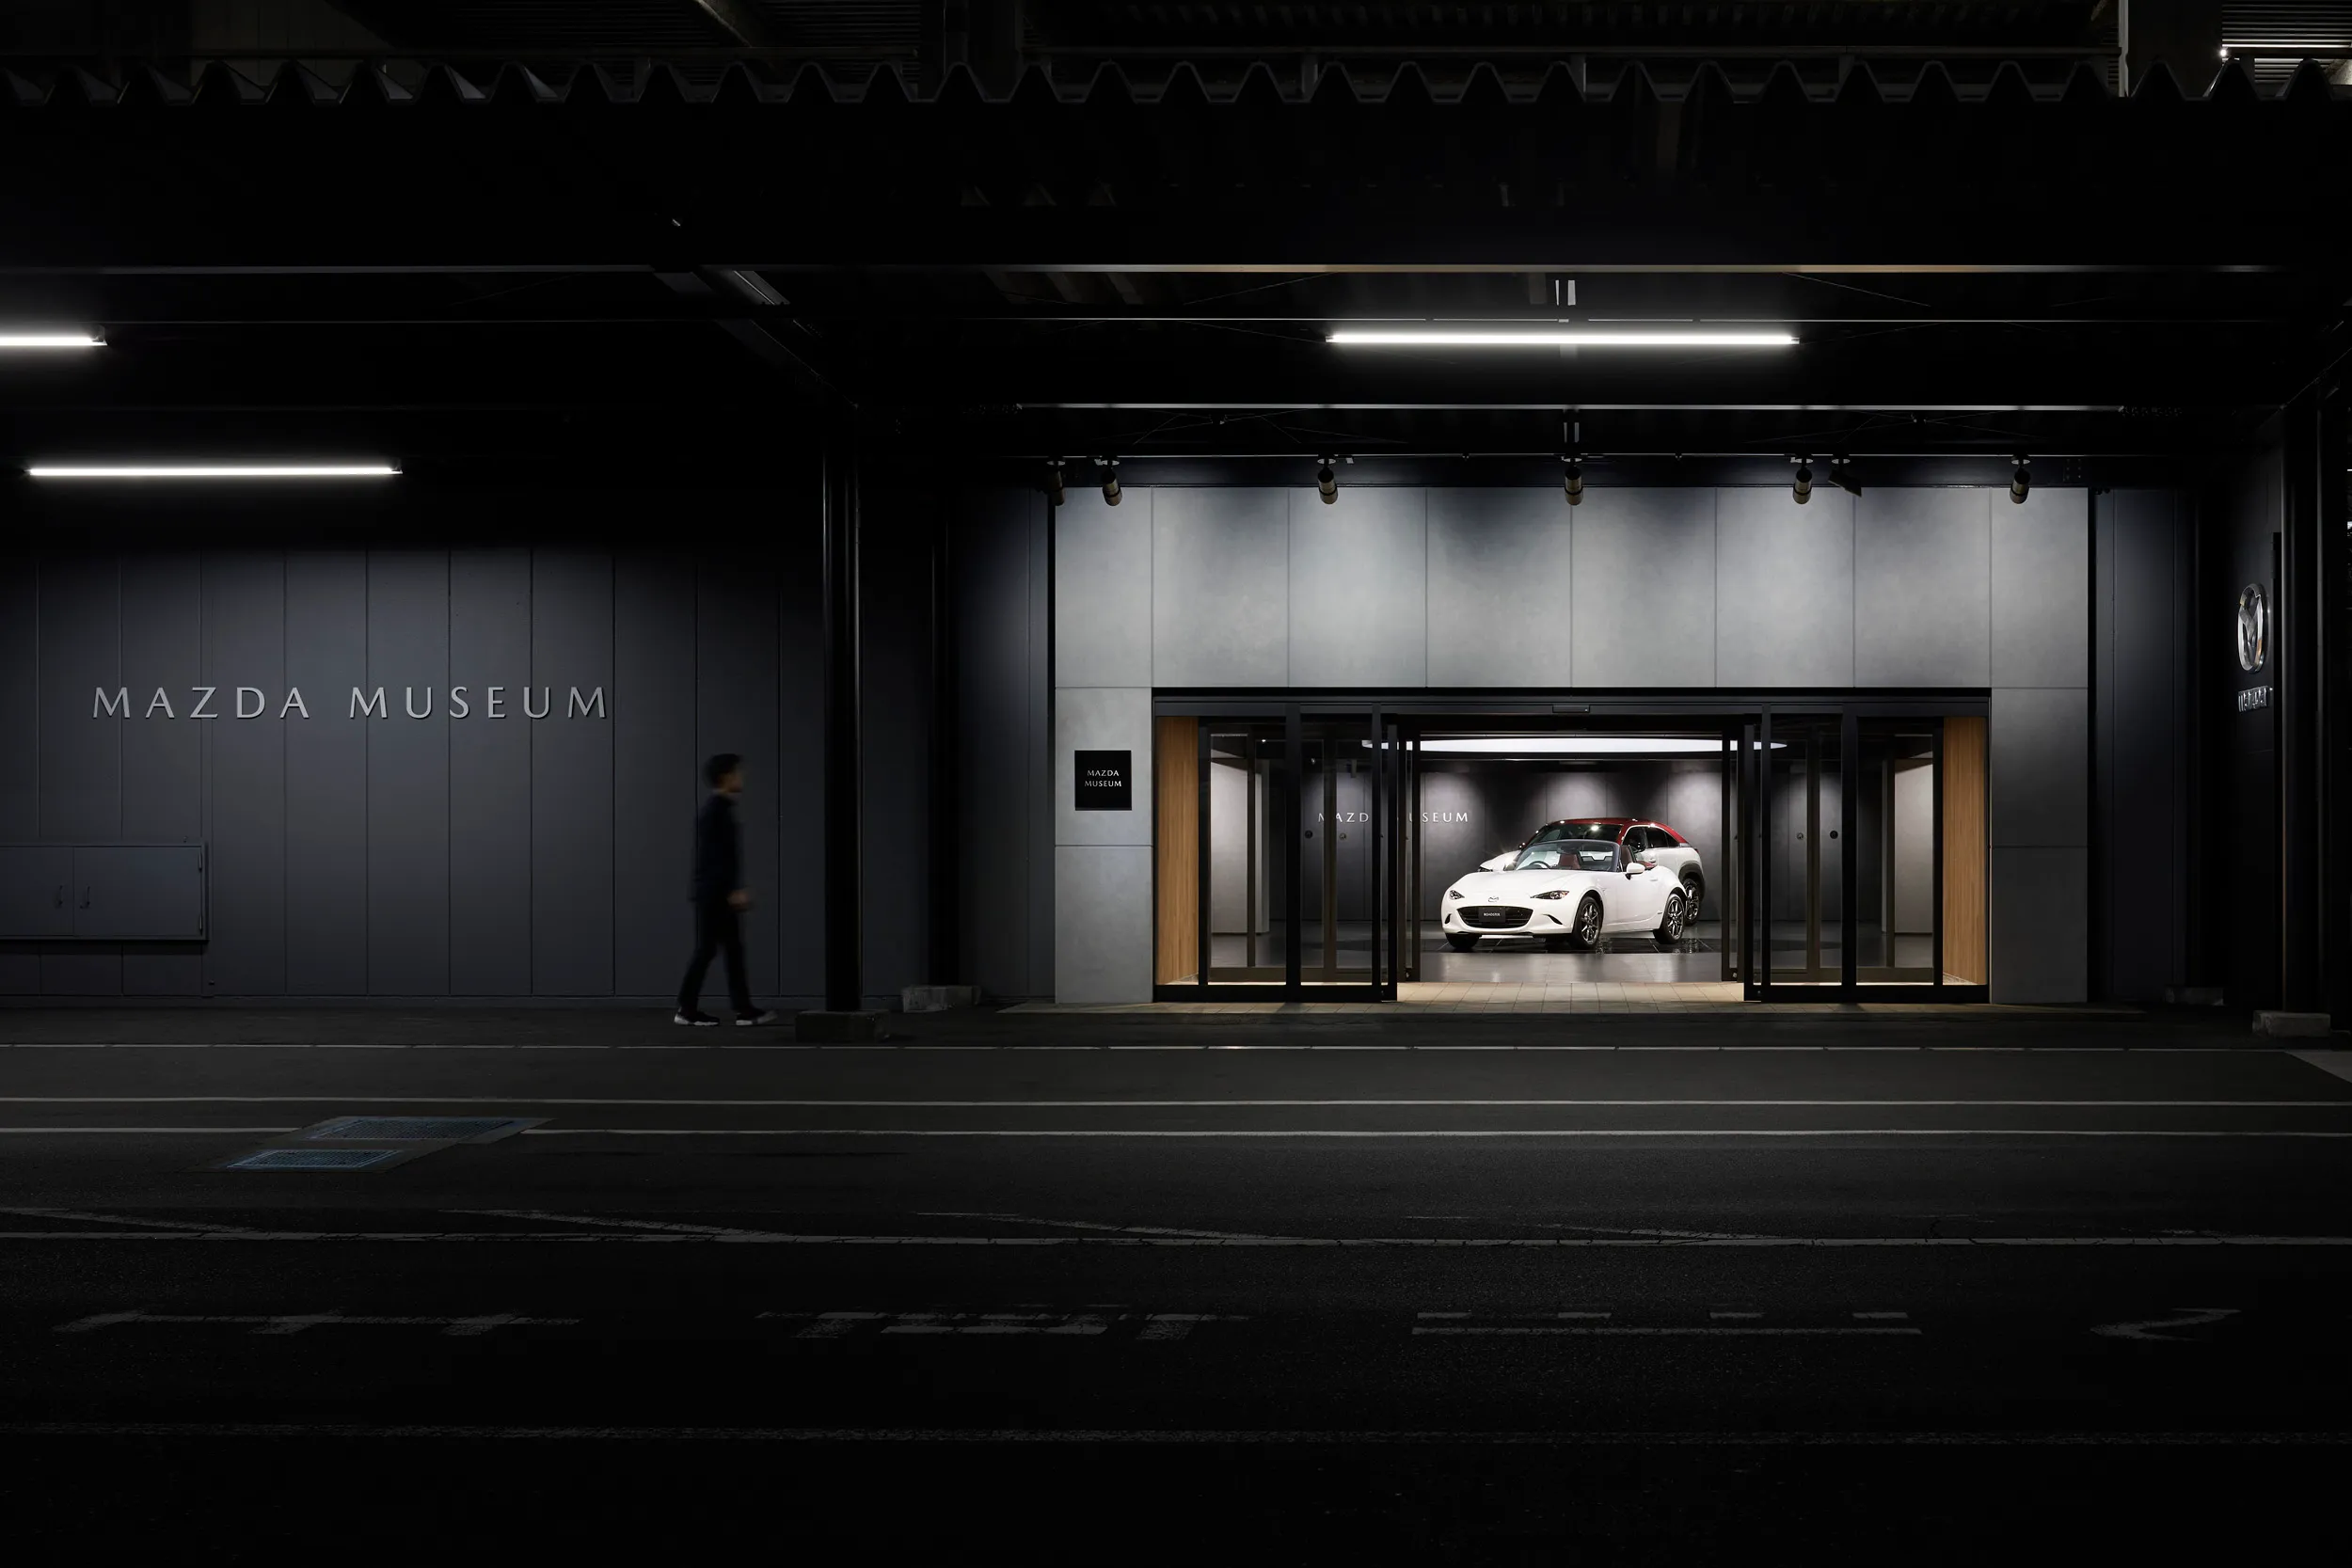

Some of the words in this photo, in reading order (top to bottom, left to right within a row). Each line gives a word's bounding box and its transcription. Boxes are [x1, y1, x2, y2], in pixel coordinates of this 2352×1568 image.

[92, 686, 310, 720] MAZDA
[349, 686, 609, 720] MUSEUM
[1318, 812, 1370, 823] MAZD
